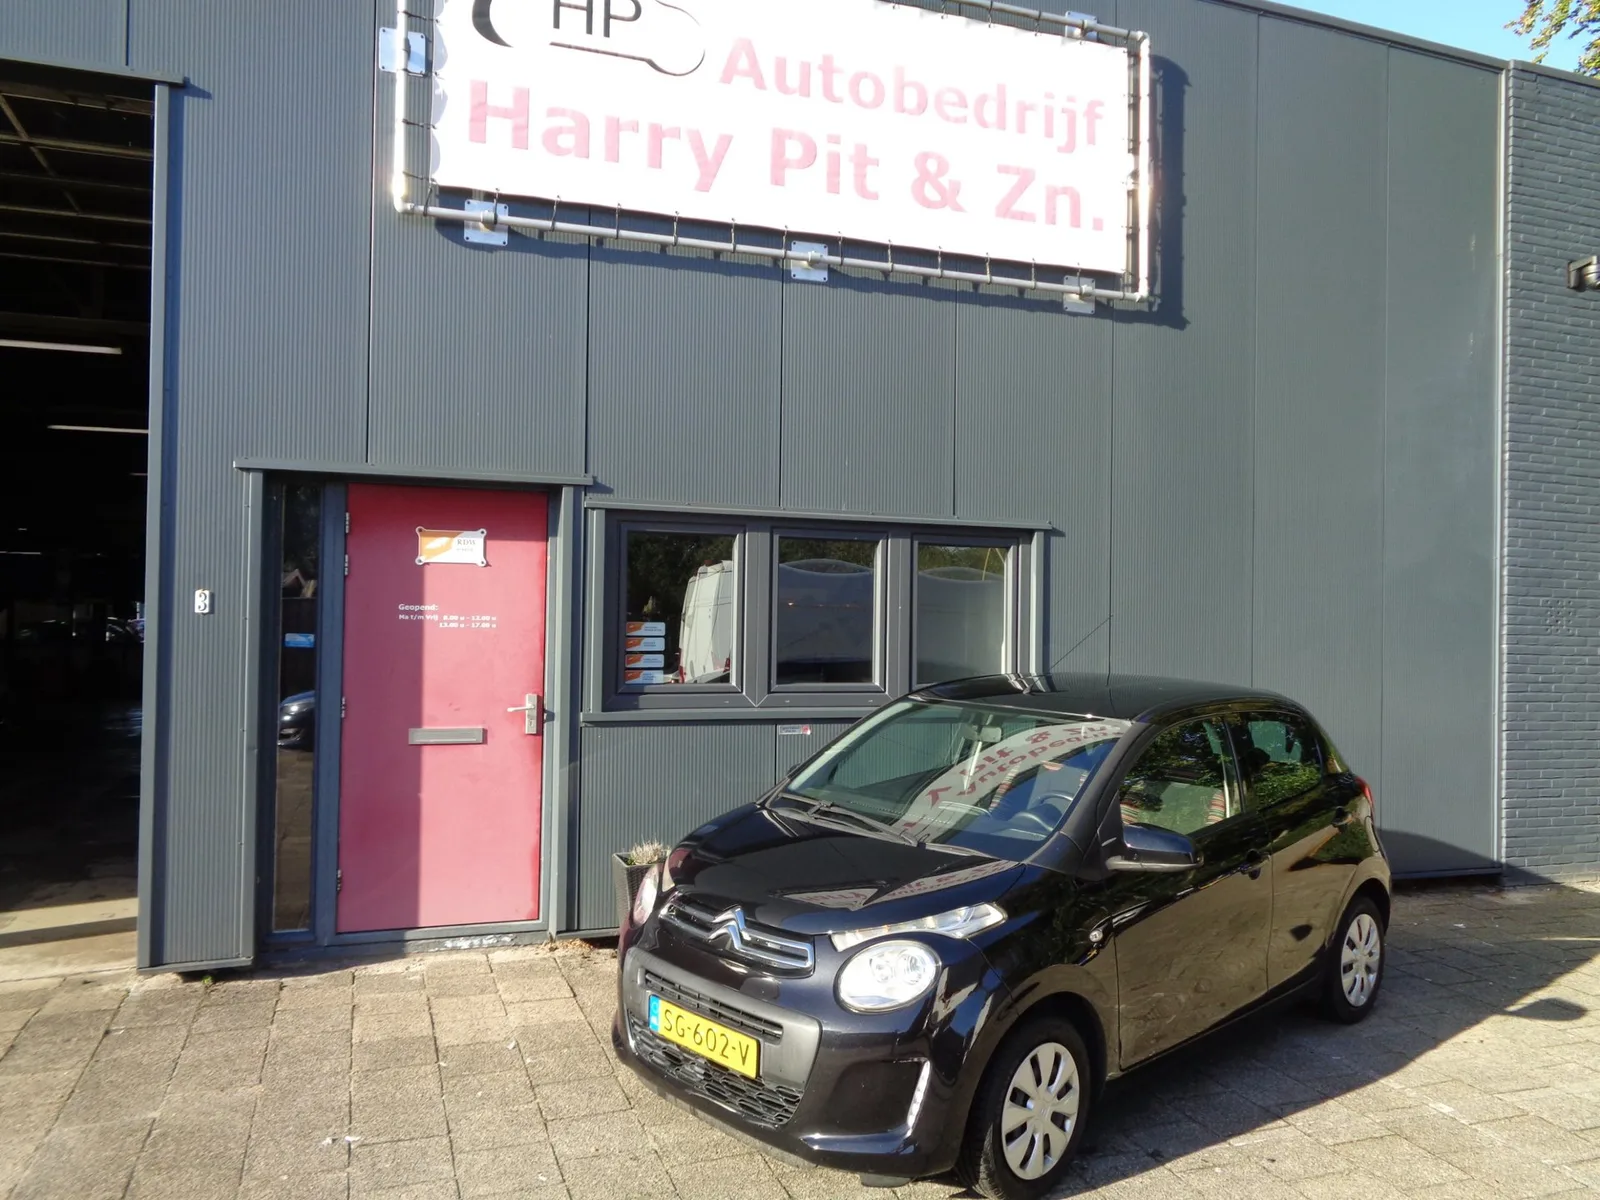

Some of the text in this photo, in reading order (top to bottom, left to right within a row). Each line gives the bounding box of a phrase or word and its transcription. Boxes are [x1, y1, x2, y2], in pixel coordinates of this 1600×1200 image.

[719, 36, 1106, 154] Autobedrijf
[468, 78, 1105, 233] Harry Pit & Zn.
[198, 591, 208, 612] 3
[398, 603, 439, 612] Geopend:
[663, 1008, 750, 1066] SG-602-V
